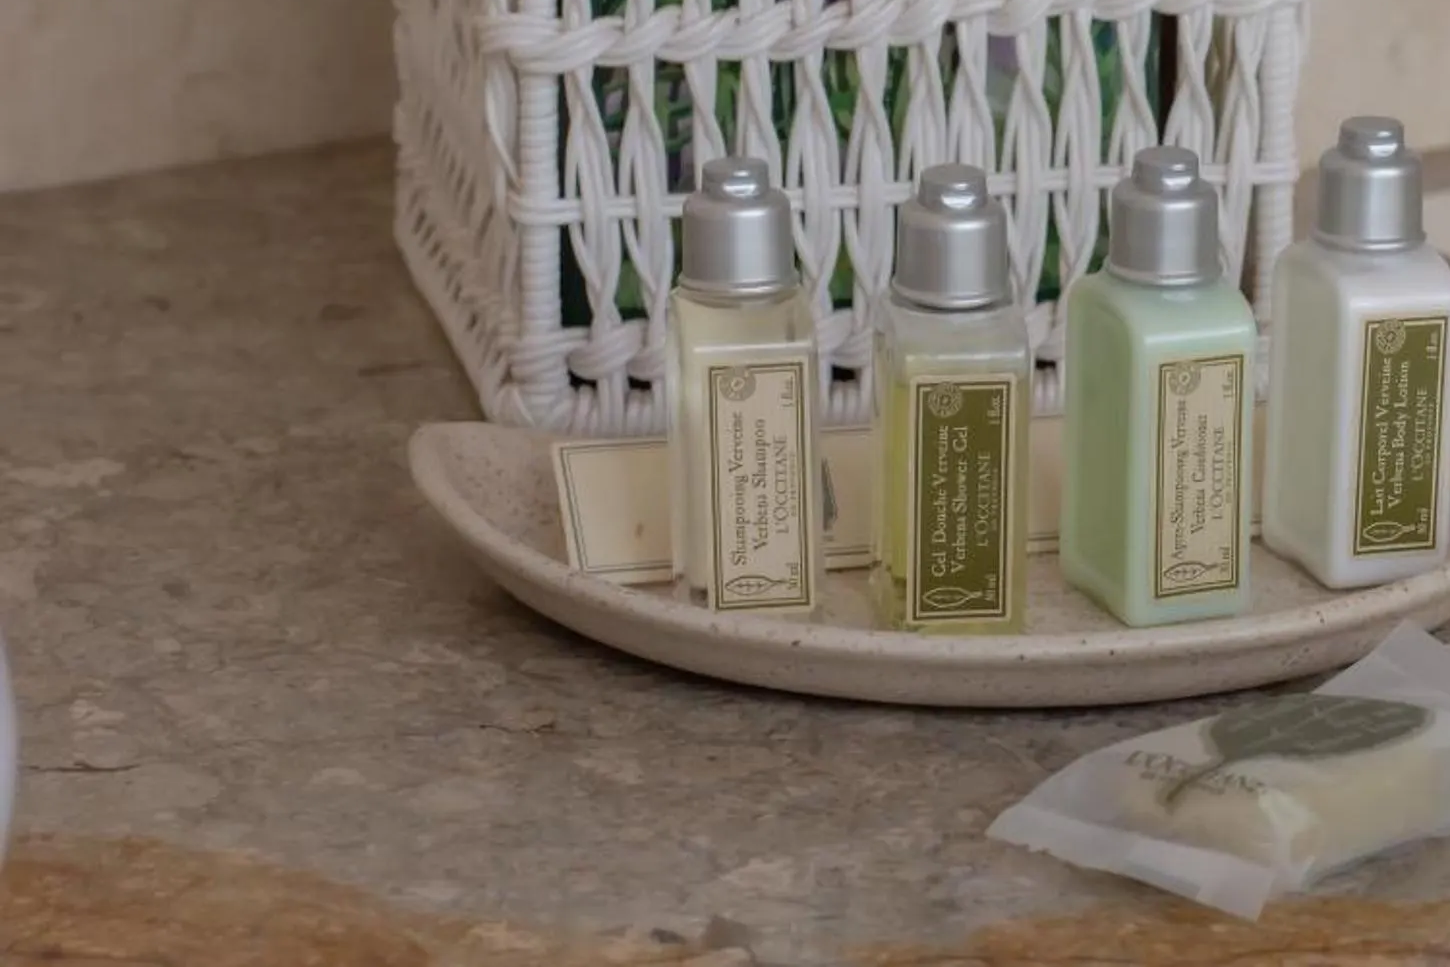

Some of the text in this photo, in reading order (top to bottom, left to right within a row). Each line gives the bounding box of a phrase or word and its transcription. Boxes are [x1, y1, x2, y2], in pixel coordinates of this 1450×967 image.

[728, 411, 749, 566] Shampooing Verveine
[752, 419, 771, 550] Verbena Shampoo
[773, 435, 788, 534] L'OCCITANE
[1210, 426, 1224, 520] L'OCCITANE
[1370, 358, 1392, 515] Lait Corporel Verveine
[1389, 361, 1408, 508] Verbena Body Lotion
[1411, 386, 1427, 480] L'OCCITANE
[932, 426, 949, 577] Gel Douche Verveine
[951, 426, 968, 573] Verbena Shower Gel
[975, 452, 990, 546] L'OCCITANE
[1191, 489, 1205, 534] Verbena
